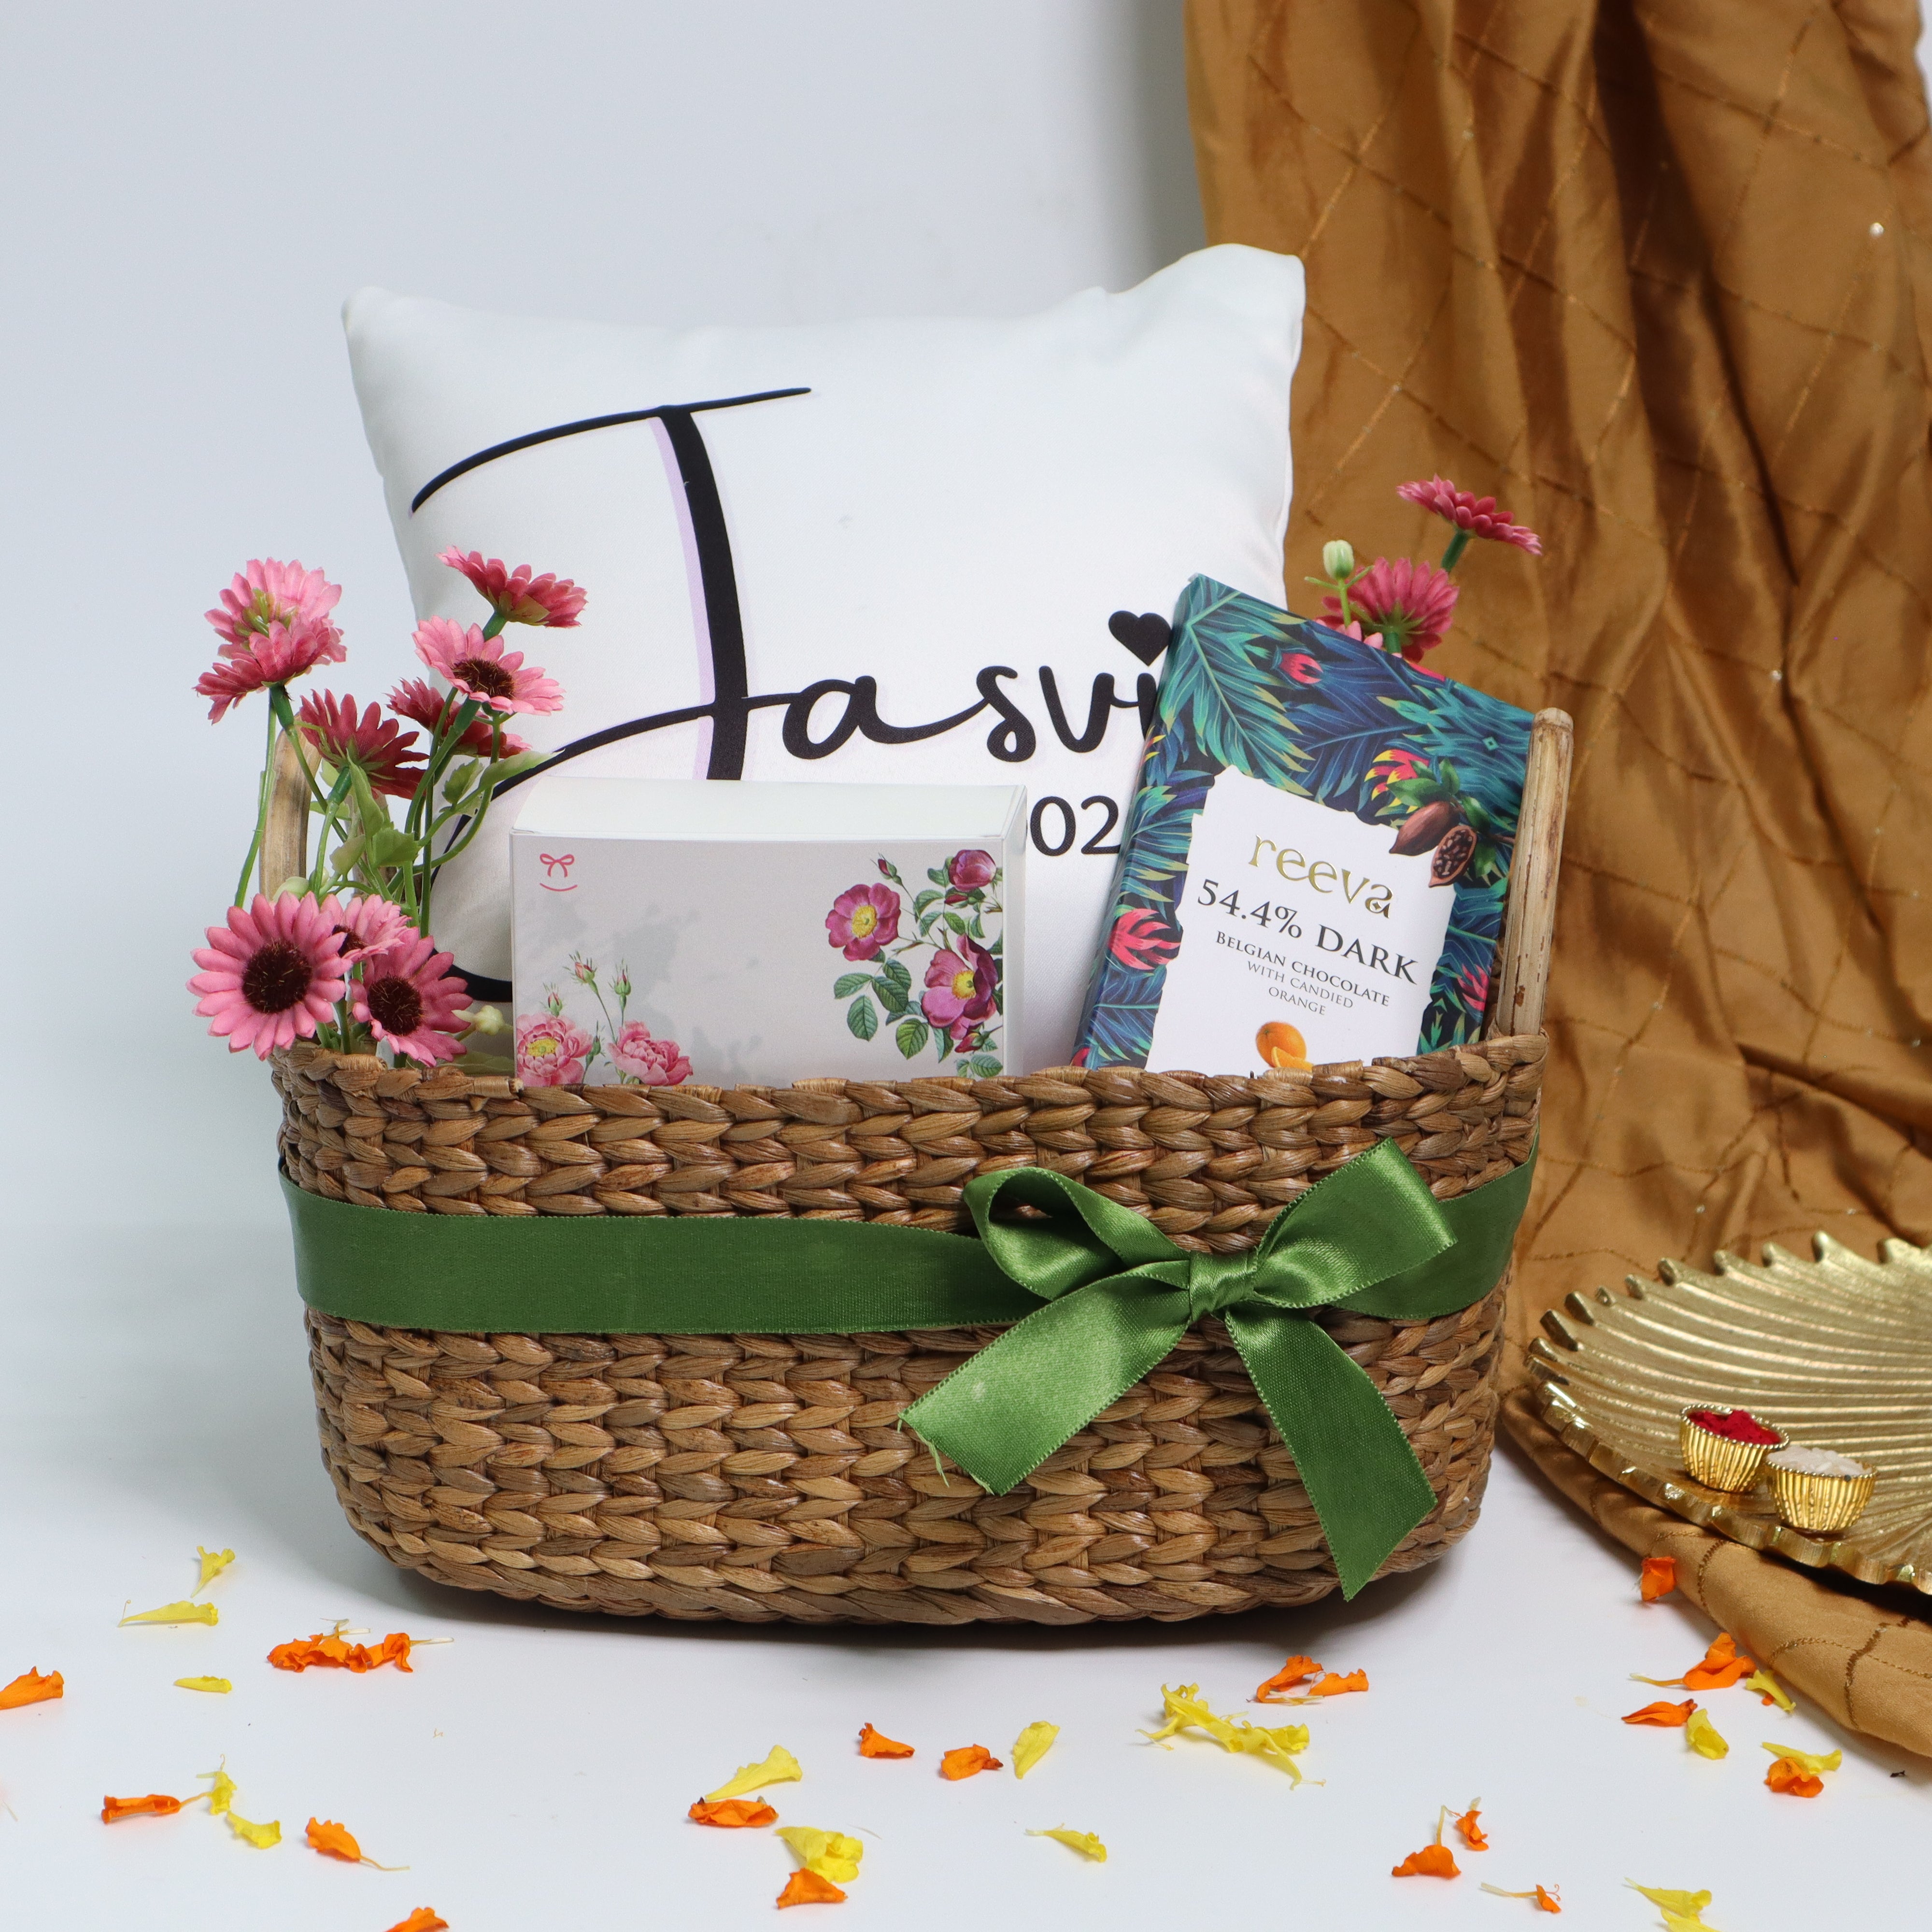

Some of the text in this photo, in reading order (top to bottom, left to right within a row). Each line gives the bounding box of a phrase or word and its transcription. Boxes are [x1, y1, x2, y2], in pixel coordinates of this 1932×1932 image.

[1026, 795, 1121, 857] 02
[1248, 834, 1394, 919] reeva
[1197, 879, 1418, 985] 54.4% DARK
[1216, 930, 1390, 1007] BELGIAN CHOCOLATE
[1247, 960, 1353, 1009] WITH CANDIED
[1268, 986, 1326, 1016] ORANGE
